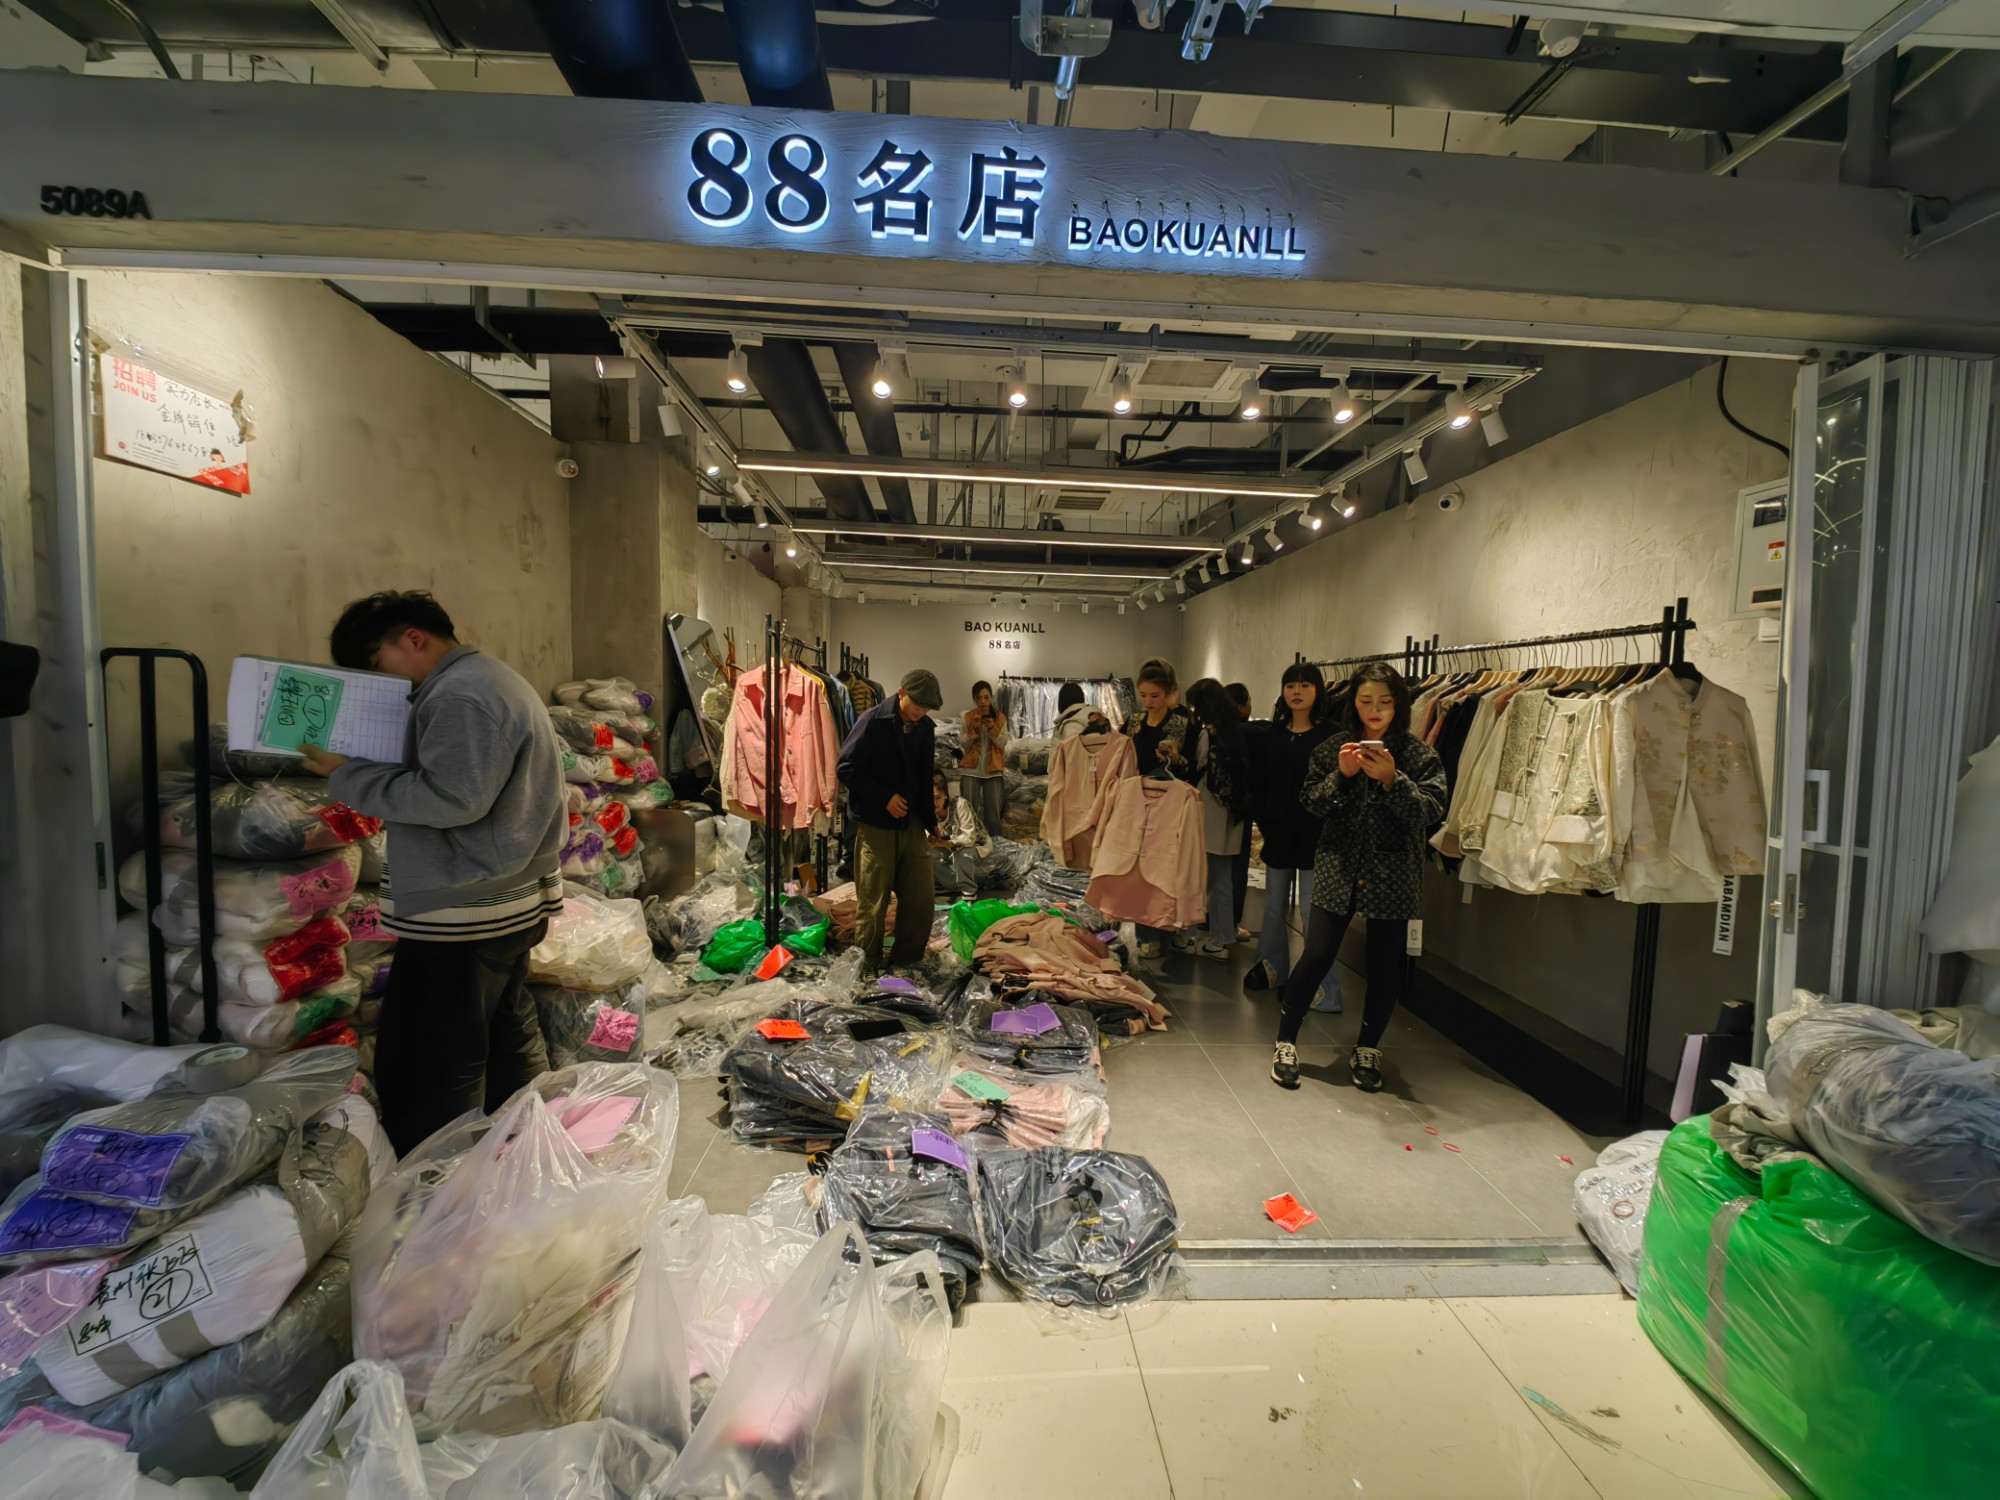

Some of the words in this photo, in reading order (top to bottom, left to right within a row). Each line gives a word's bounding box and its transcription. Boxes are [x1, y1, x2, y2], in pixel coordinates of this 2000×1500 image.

[40, 185, 152, 219] 5089A
[687, 128, 1047, 244] 88名店
[1067, 213, 1306, 260] BAOKUANLL
[112, 357, 157, 391] 招聘
[113, 380, 139, 397] JOIN
[142, 391, 157, 403] US
